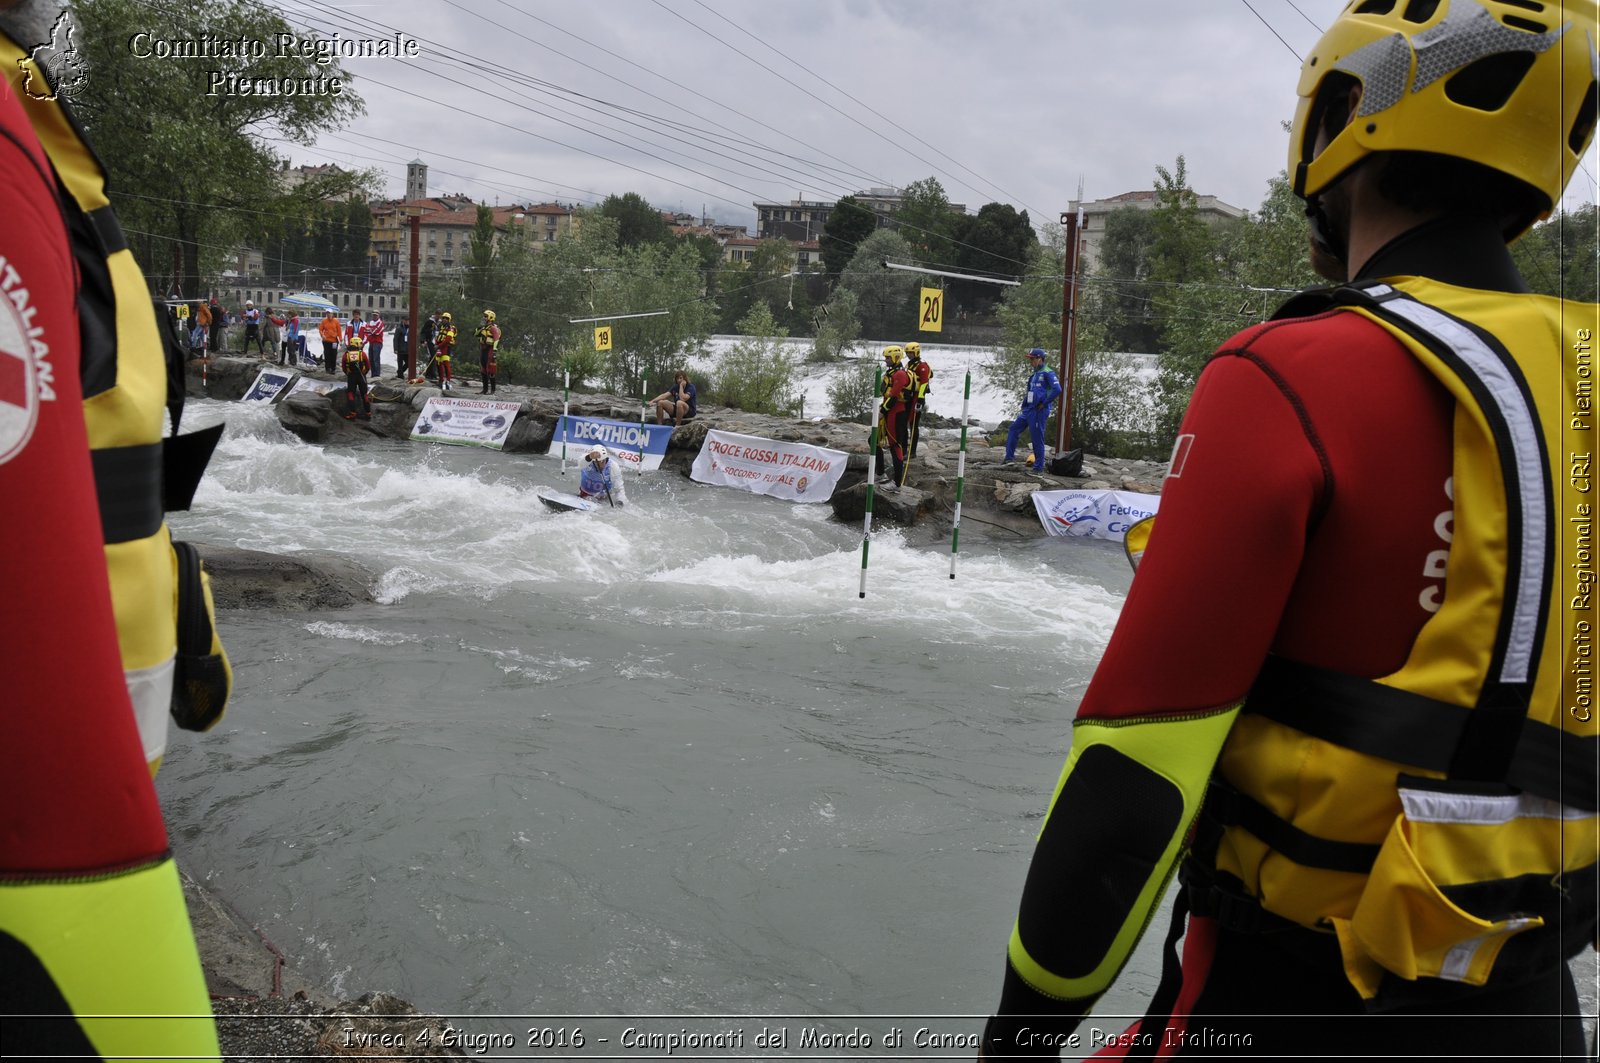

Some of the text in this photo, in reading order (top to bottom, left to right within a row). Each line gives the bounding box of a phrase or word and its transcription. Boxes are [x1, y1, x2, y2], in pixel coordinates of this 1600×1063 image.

[924, 296, 939, 322] 20
[598, 331, 609, 346] 19
[457, 400, 490, 409] ASSISTENZA
[574, 421, 650, 447] DECATHLON
[708, 440, 832, 473] CROCE ROSSA ITALIANA
[724, 466, 761, 480] SOCCORSO
